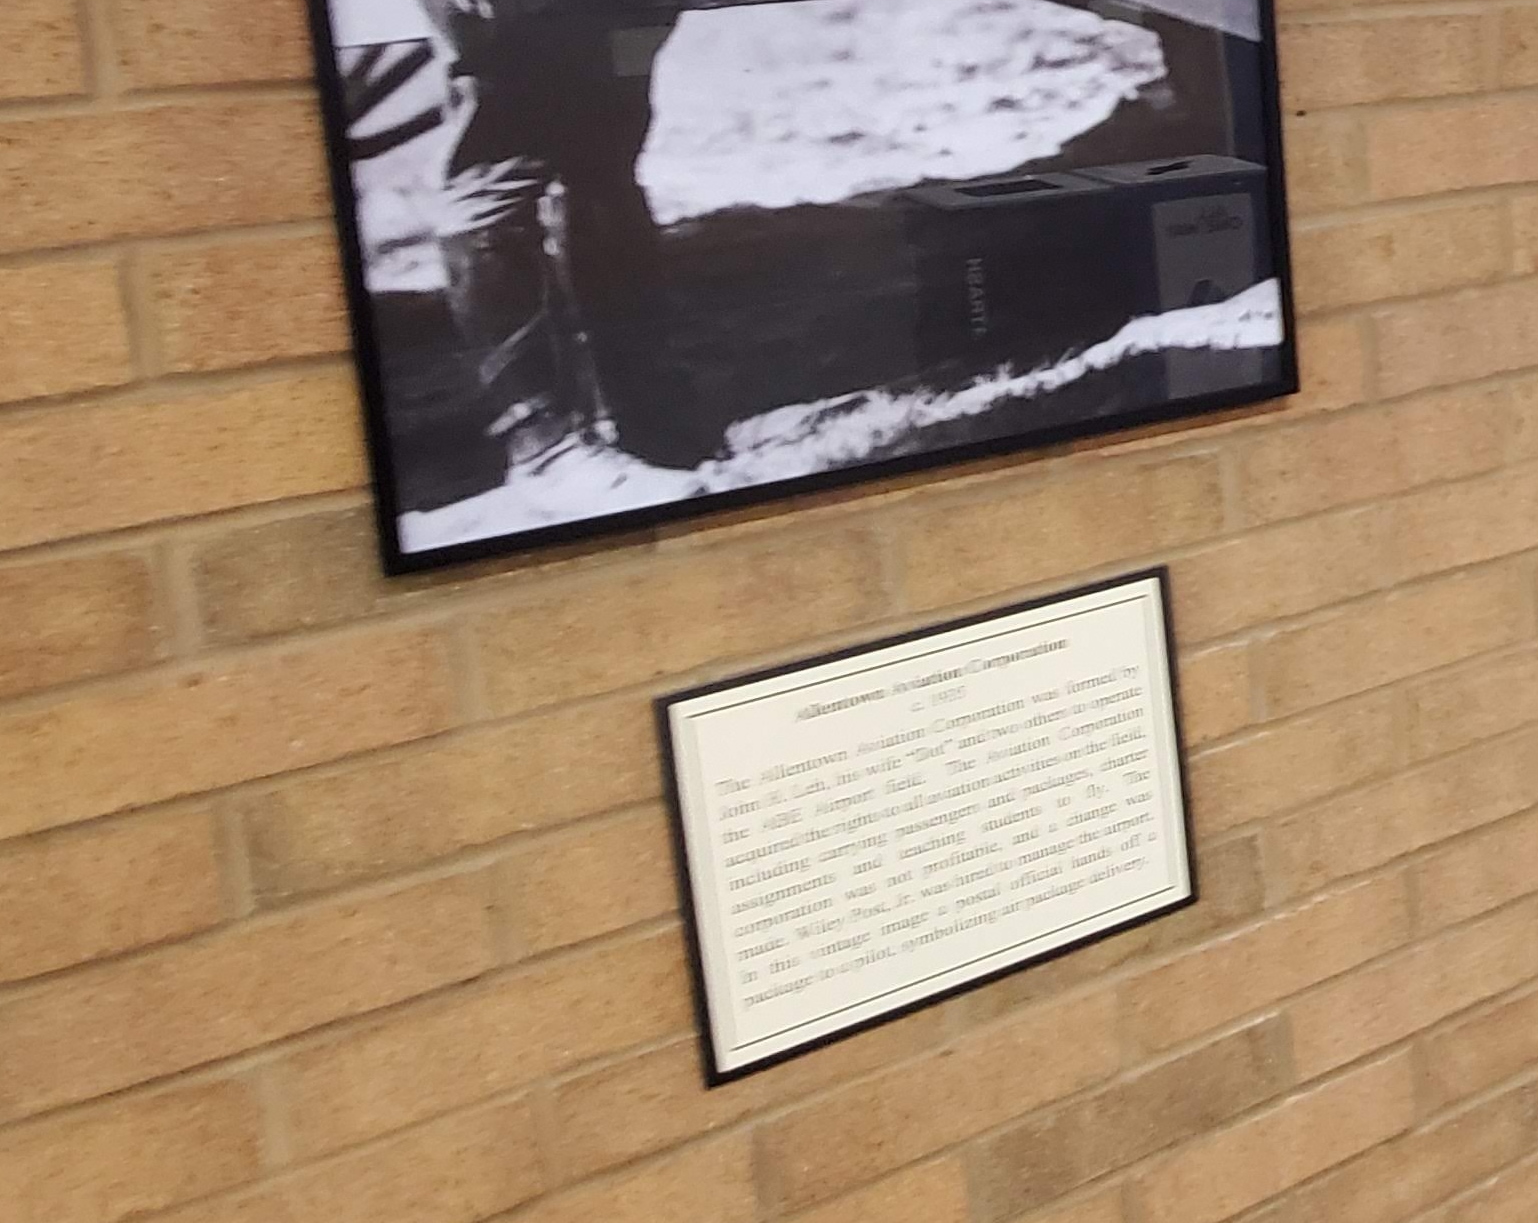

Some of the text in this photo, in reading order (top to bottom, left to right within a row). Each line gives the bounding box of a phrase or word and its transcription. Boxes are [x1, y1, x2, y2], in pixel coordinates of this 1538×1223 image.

[760, 751, 847, 784] Allentown
[856, 729, 925, 756] Aviation
[934, 700, 1025, 734] Corporation
[1067, 670, 1117, 695] formed
[892, 669, 962, 695] Aviation
[966, 641, 1069, 675] Corporation
[867, 757, 902, 777] wife
[1025, 710, 1067, 730] others
[1092, 686, 1142, 710] operate
[987, 737, 1050, 764] Aviation
[1060, 709, 1144, 741] Corporation
[726, 833, 799, 868] acquired
[834, 811, 880, 834] rights
[929, 778, 989, 804] aviation
[994, 757, 1059, 784] activities
[729, 858, 811, 891] including
[819, 834, 888, 863] carrying
[896, 804, 979, 841] passengers
[1023, 771, 1093, 800] packages,
[1101, 751, 1149, 772] charter
[732, 872, 836, 914] assignments
[899, 831, 966, 860] teaching
[982, 805, 1042, 833] students
[1087, 784, 1109, 798] fly.
[736, 898, 833, 939] corporation
[923, 843, 1002, 879] profitable,
[1068, 804, 1117, 827] change
[739, 939, 790, 962] made.
[1019, 839, 1074, 865] manage
[745, 976, 814, 1011] package
[902, 911, 997, 951] symbolizing
[1026, 879, 1085, 910] package
[1090, 859, 1149, 884] delivery.
[769, 956, 800, 975] this
[812, 932, 871, 960] vintage
[881, 912, 929, 936] image
[955, 884, 1000, 913] postal
[1012, 862, 1062, 890] official
[1072, 848, 1112, 869] hands
